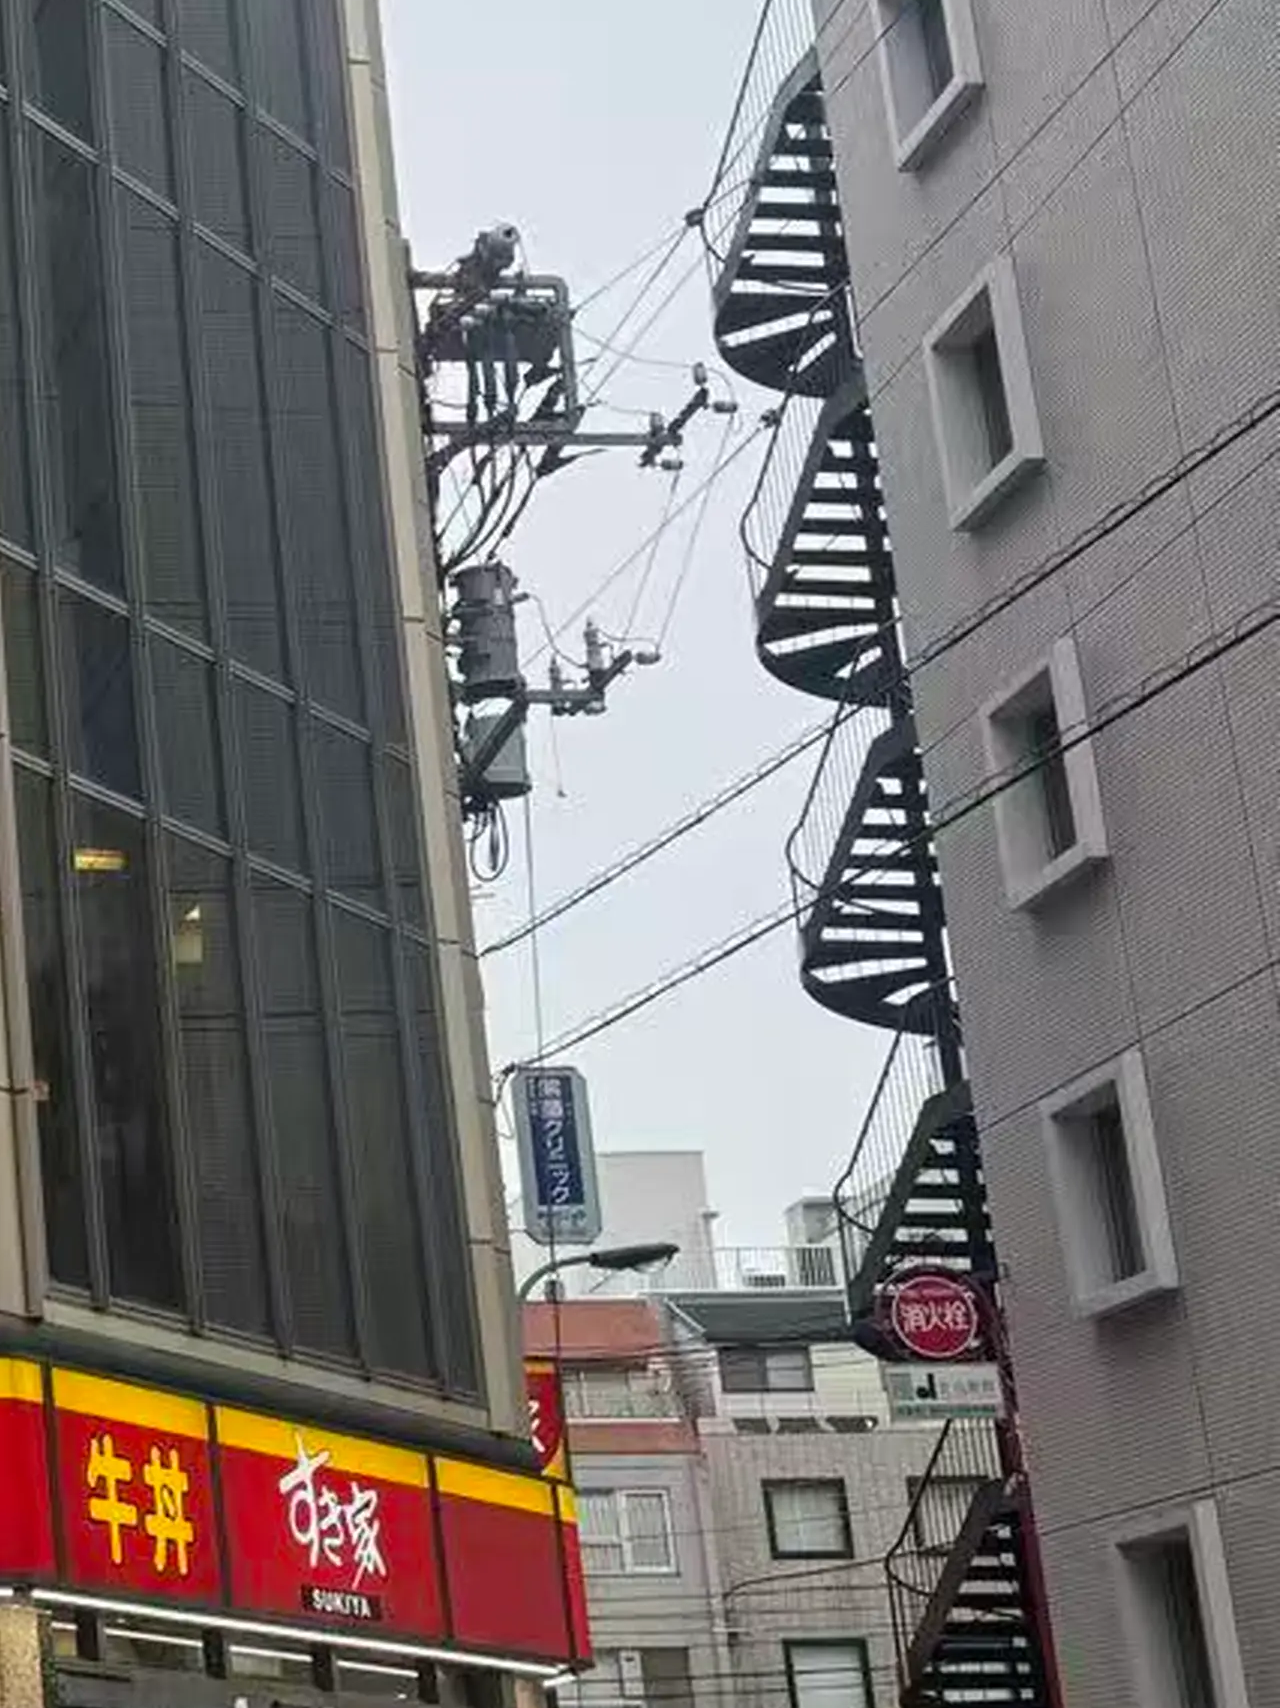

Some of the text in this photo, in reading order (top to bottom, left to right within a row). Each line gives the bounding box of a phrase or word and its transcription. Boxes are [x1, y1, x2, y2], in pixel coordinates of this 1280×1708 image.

[898, 1299, 970, 1334] 消火栓
[86, 1434, 196, 1577] 牛丼
[279, 1431, 387, 1590] すき家
[311, 1589, 372, 1619] SUKIYA
